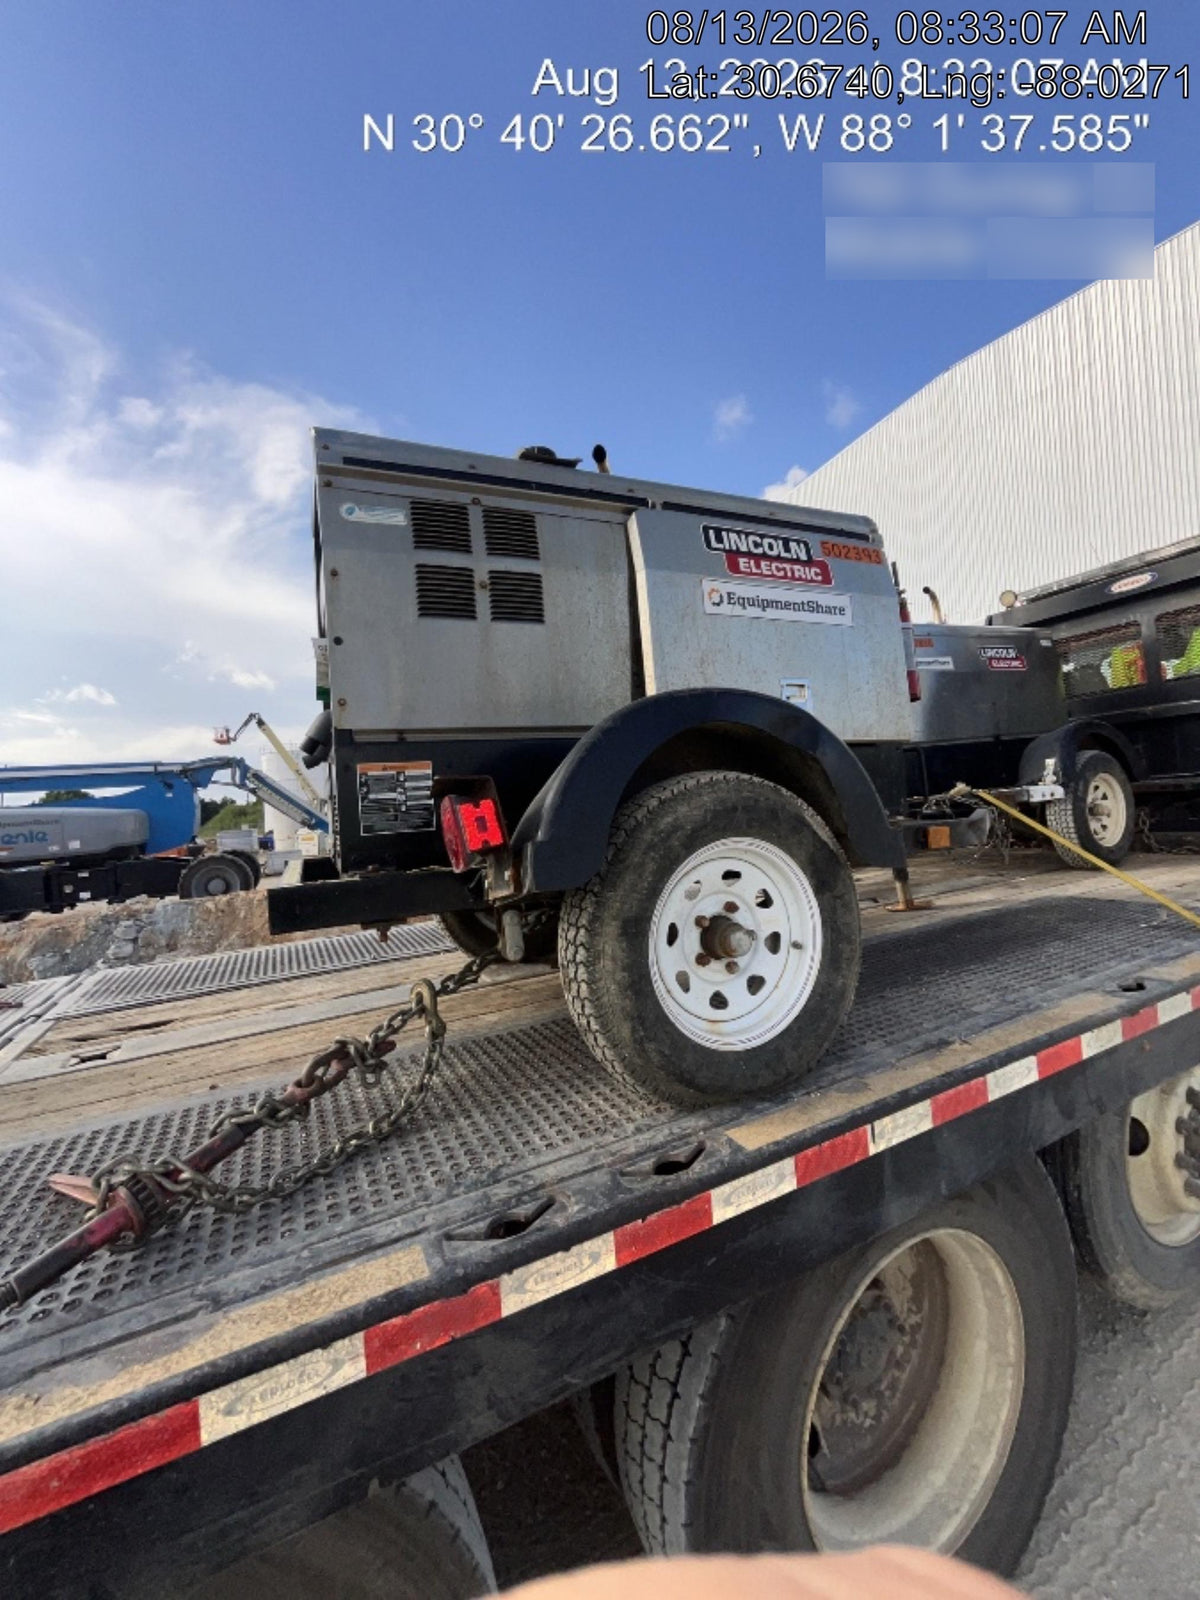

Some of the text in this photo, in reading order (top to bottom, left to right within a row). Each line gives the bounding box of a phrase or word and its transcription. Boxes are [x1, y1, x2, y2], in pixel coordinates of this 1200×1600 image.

[707, 529, 809, 561] LINCOLN
[738, 557, 823, 582] ELECTRIC
[726, 591, 847, 616] EquipmentShare
[0, 830, 49, 845] enie
